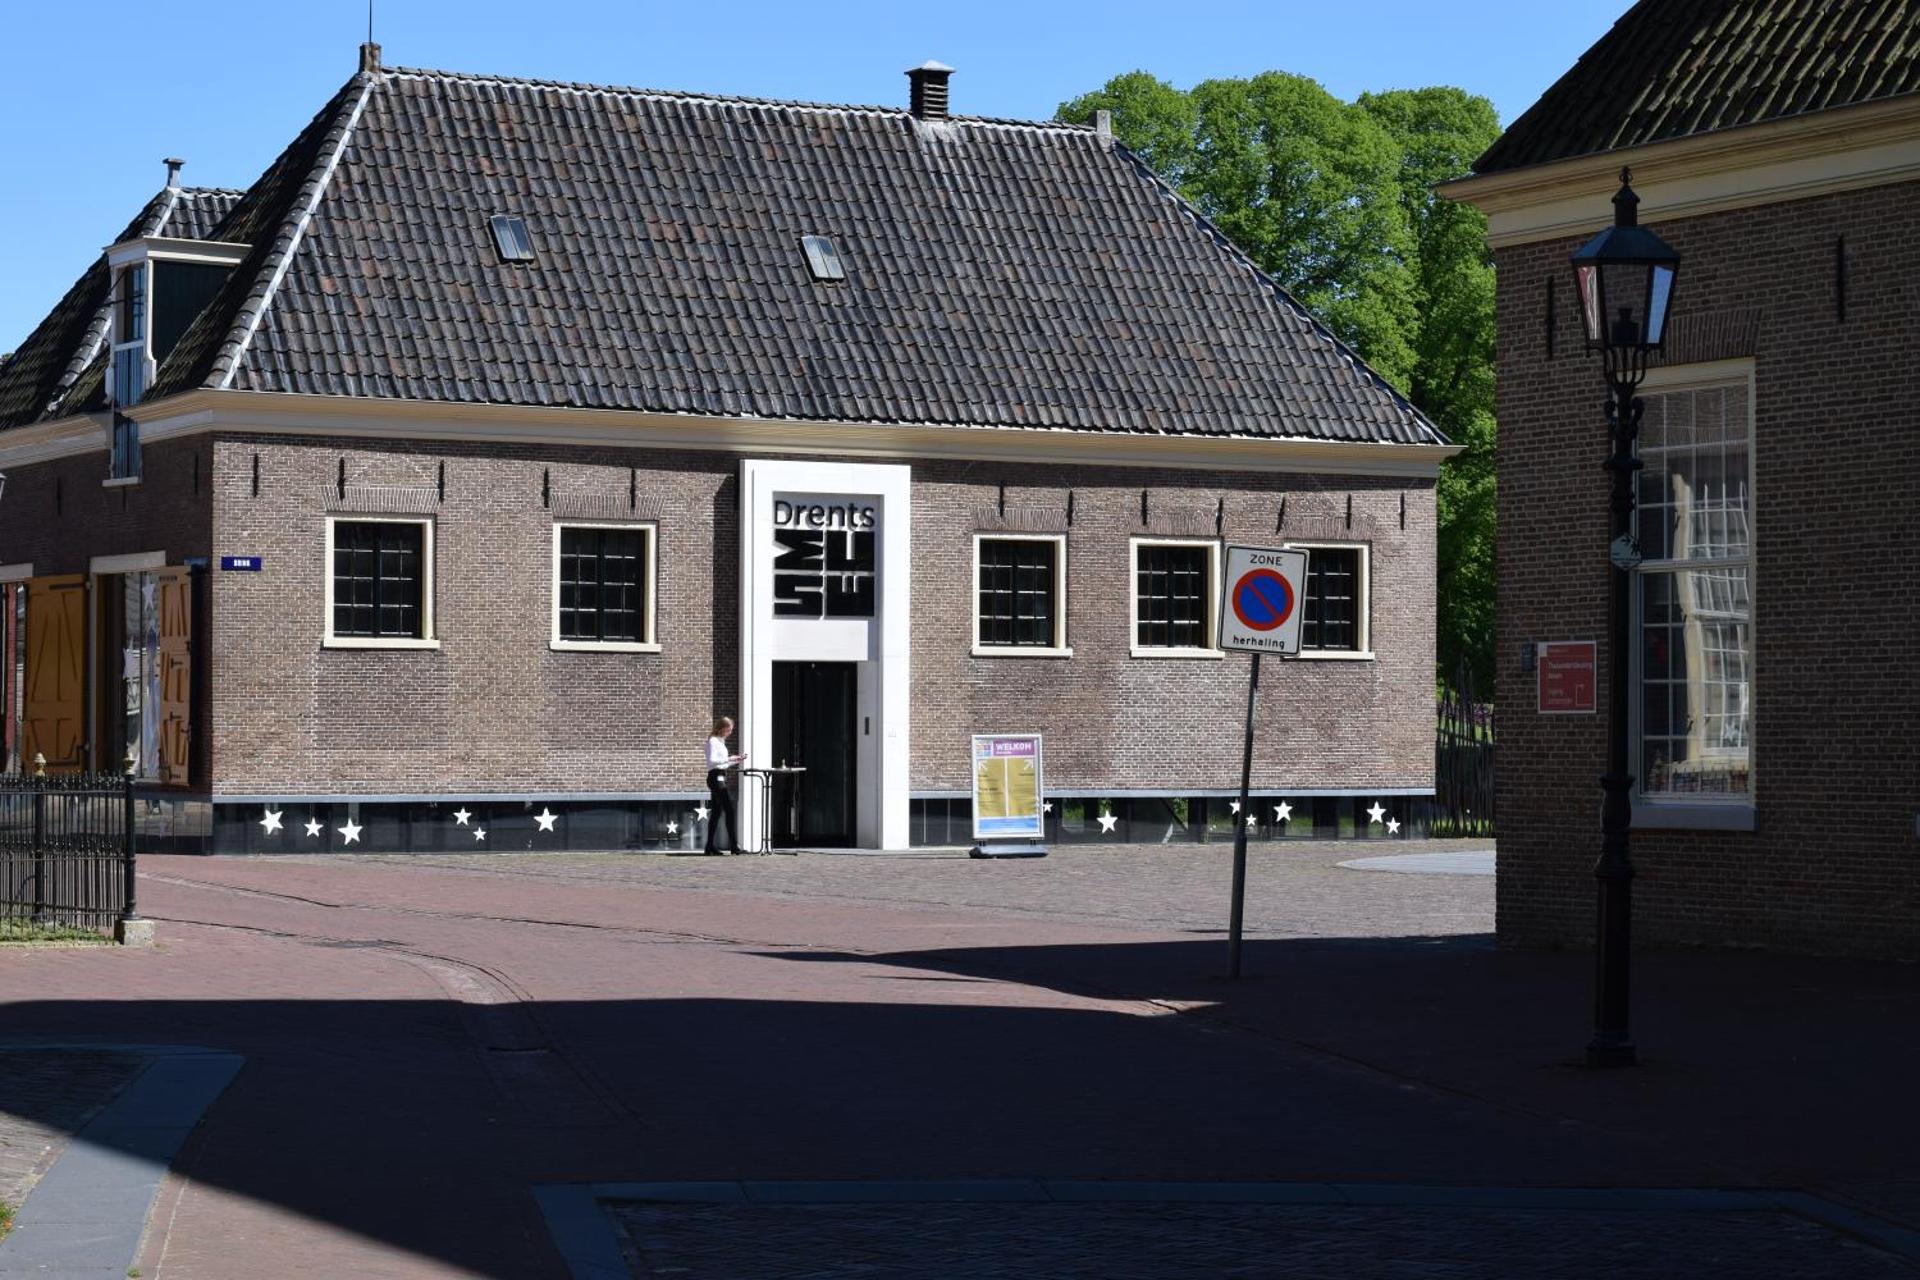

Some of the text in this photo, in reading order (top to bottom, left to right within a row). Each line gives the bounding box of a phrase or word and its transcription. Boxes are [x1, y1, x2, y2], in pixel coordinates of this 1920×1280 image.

[774, 501, 875, 527] Drents
[1250, 554, 1283, 566] ZONE
[1233, 635, 1285, 649] herhaling
[996, 742, 1032, 751] WELKOM
